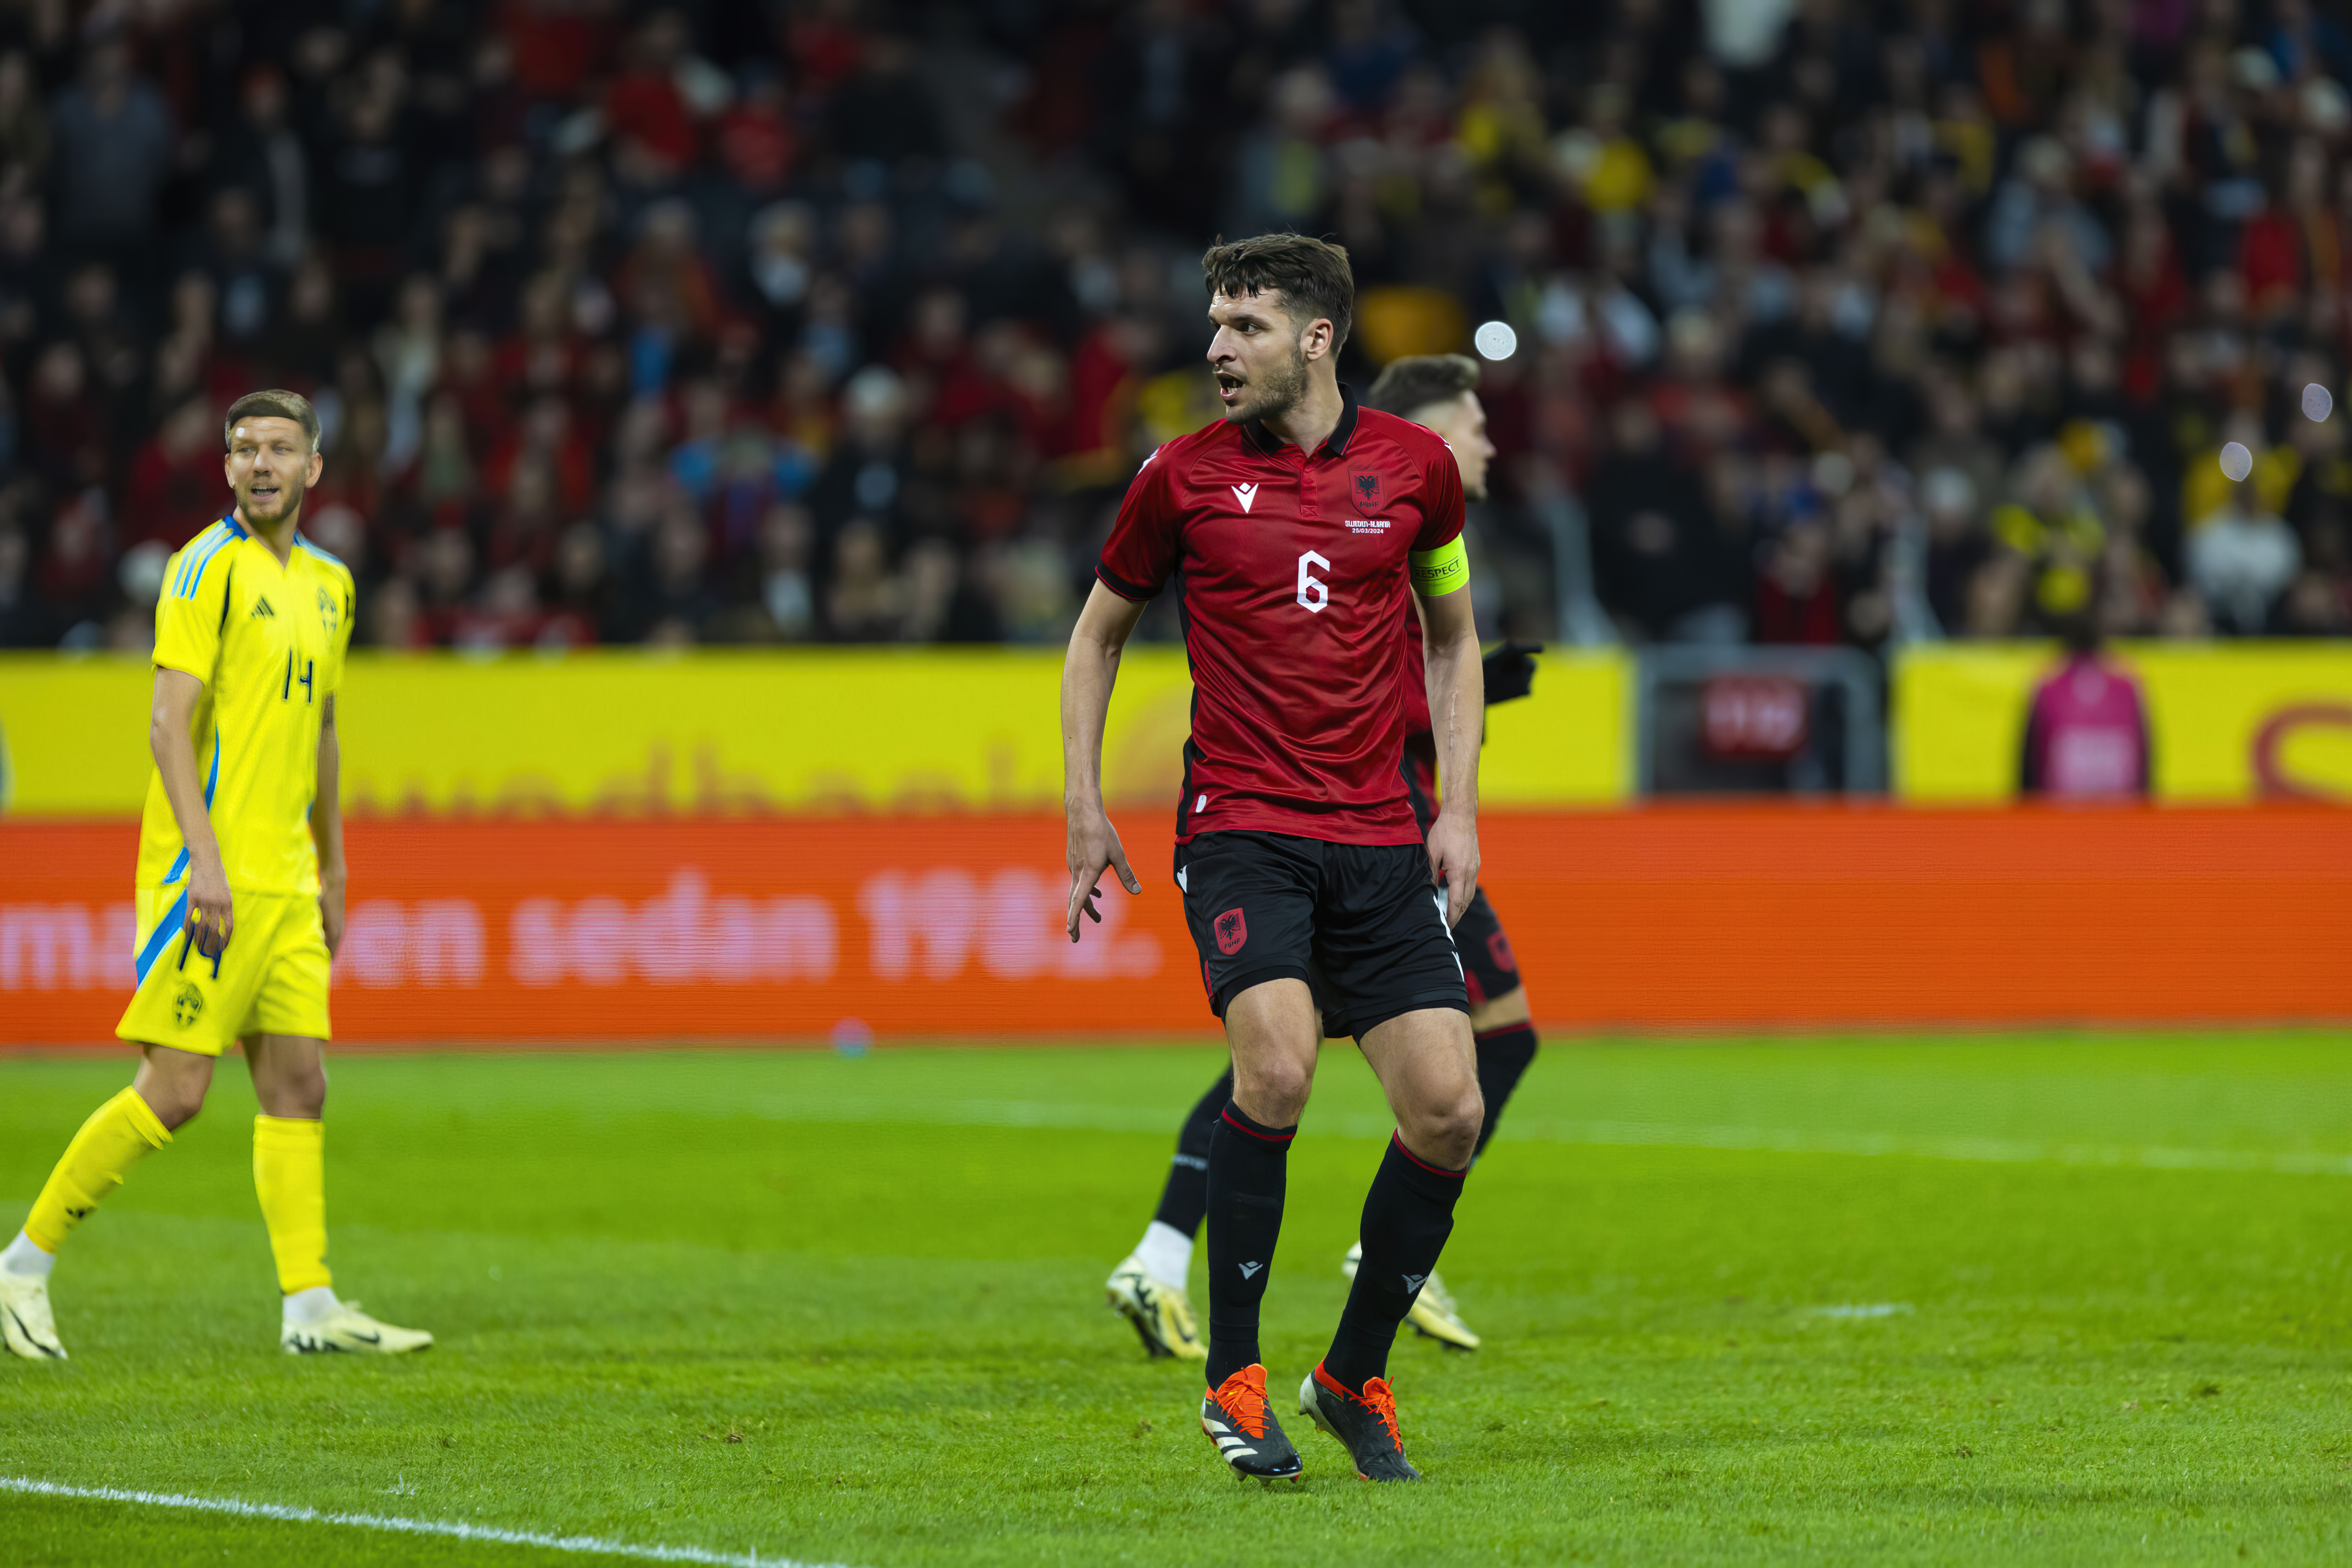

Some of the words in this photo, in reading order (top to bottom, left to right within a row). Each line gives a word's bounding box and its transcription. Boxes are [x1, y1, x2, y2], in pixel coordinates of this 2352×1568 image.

[1296, 550, 1330, 614] 6
[1415, 558, 1459, 578] RESPECT
[283, 648, 313, 703] 14
